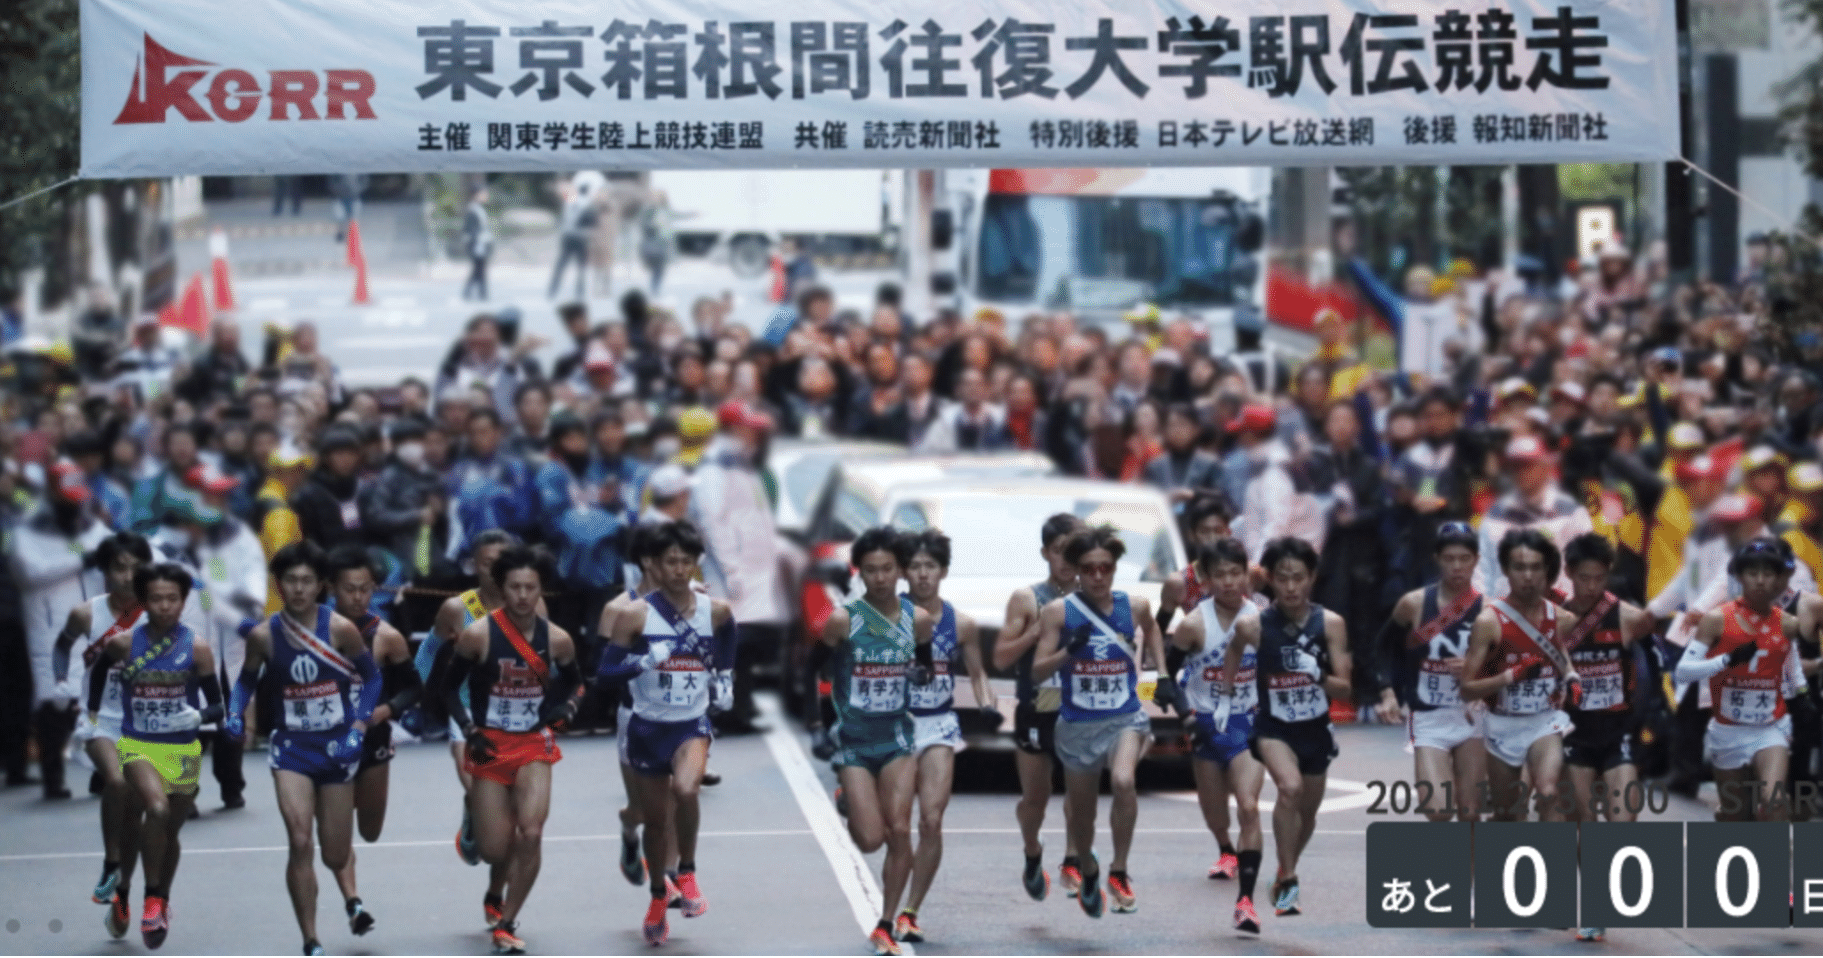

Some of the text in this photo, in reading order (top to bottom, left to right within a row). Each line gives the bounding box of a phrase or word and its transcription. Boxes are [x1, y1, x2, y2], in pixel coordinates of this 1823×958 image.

[416, 6, 1611, 101] 東京箱根間往復大学駅伝競走
[418, 112, 1608, 150] 主催 関東学生陸上競技連盟 共催 読売新聞社 特別後援 日本テレビ放送網 後援 報知新聞社
